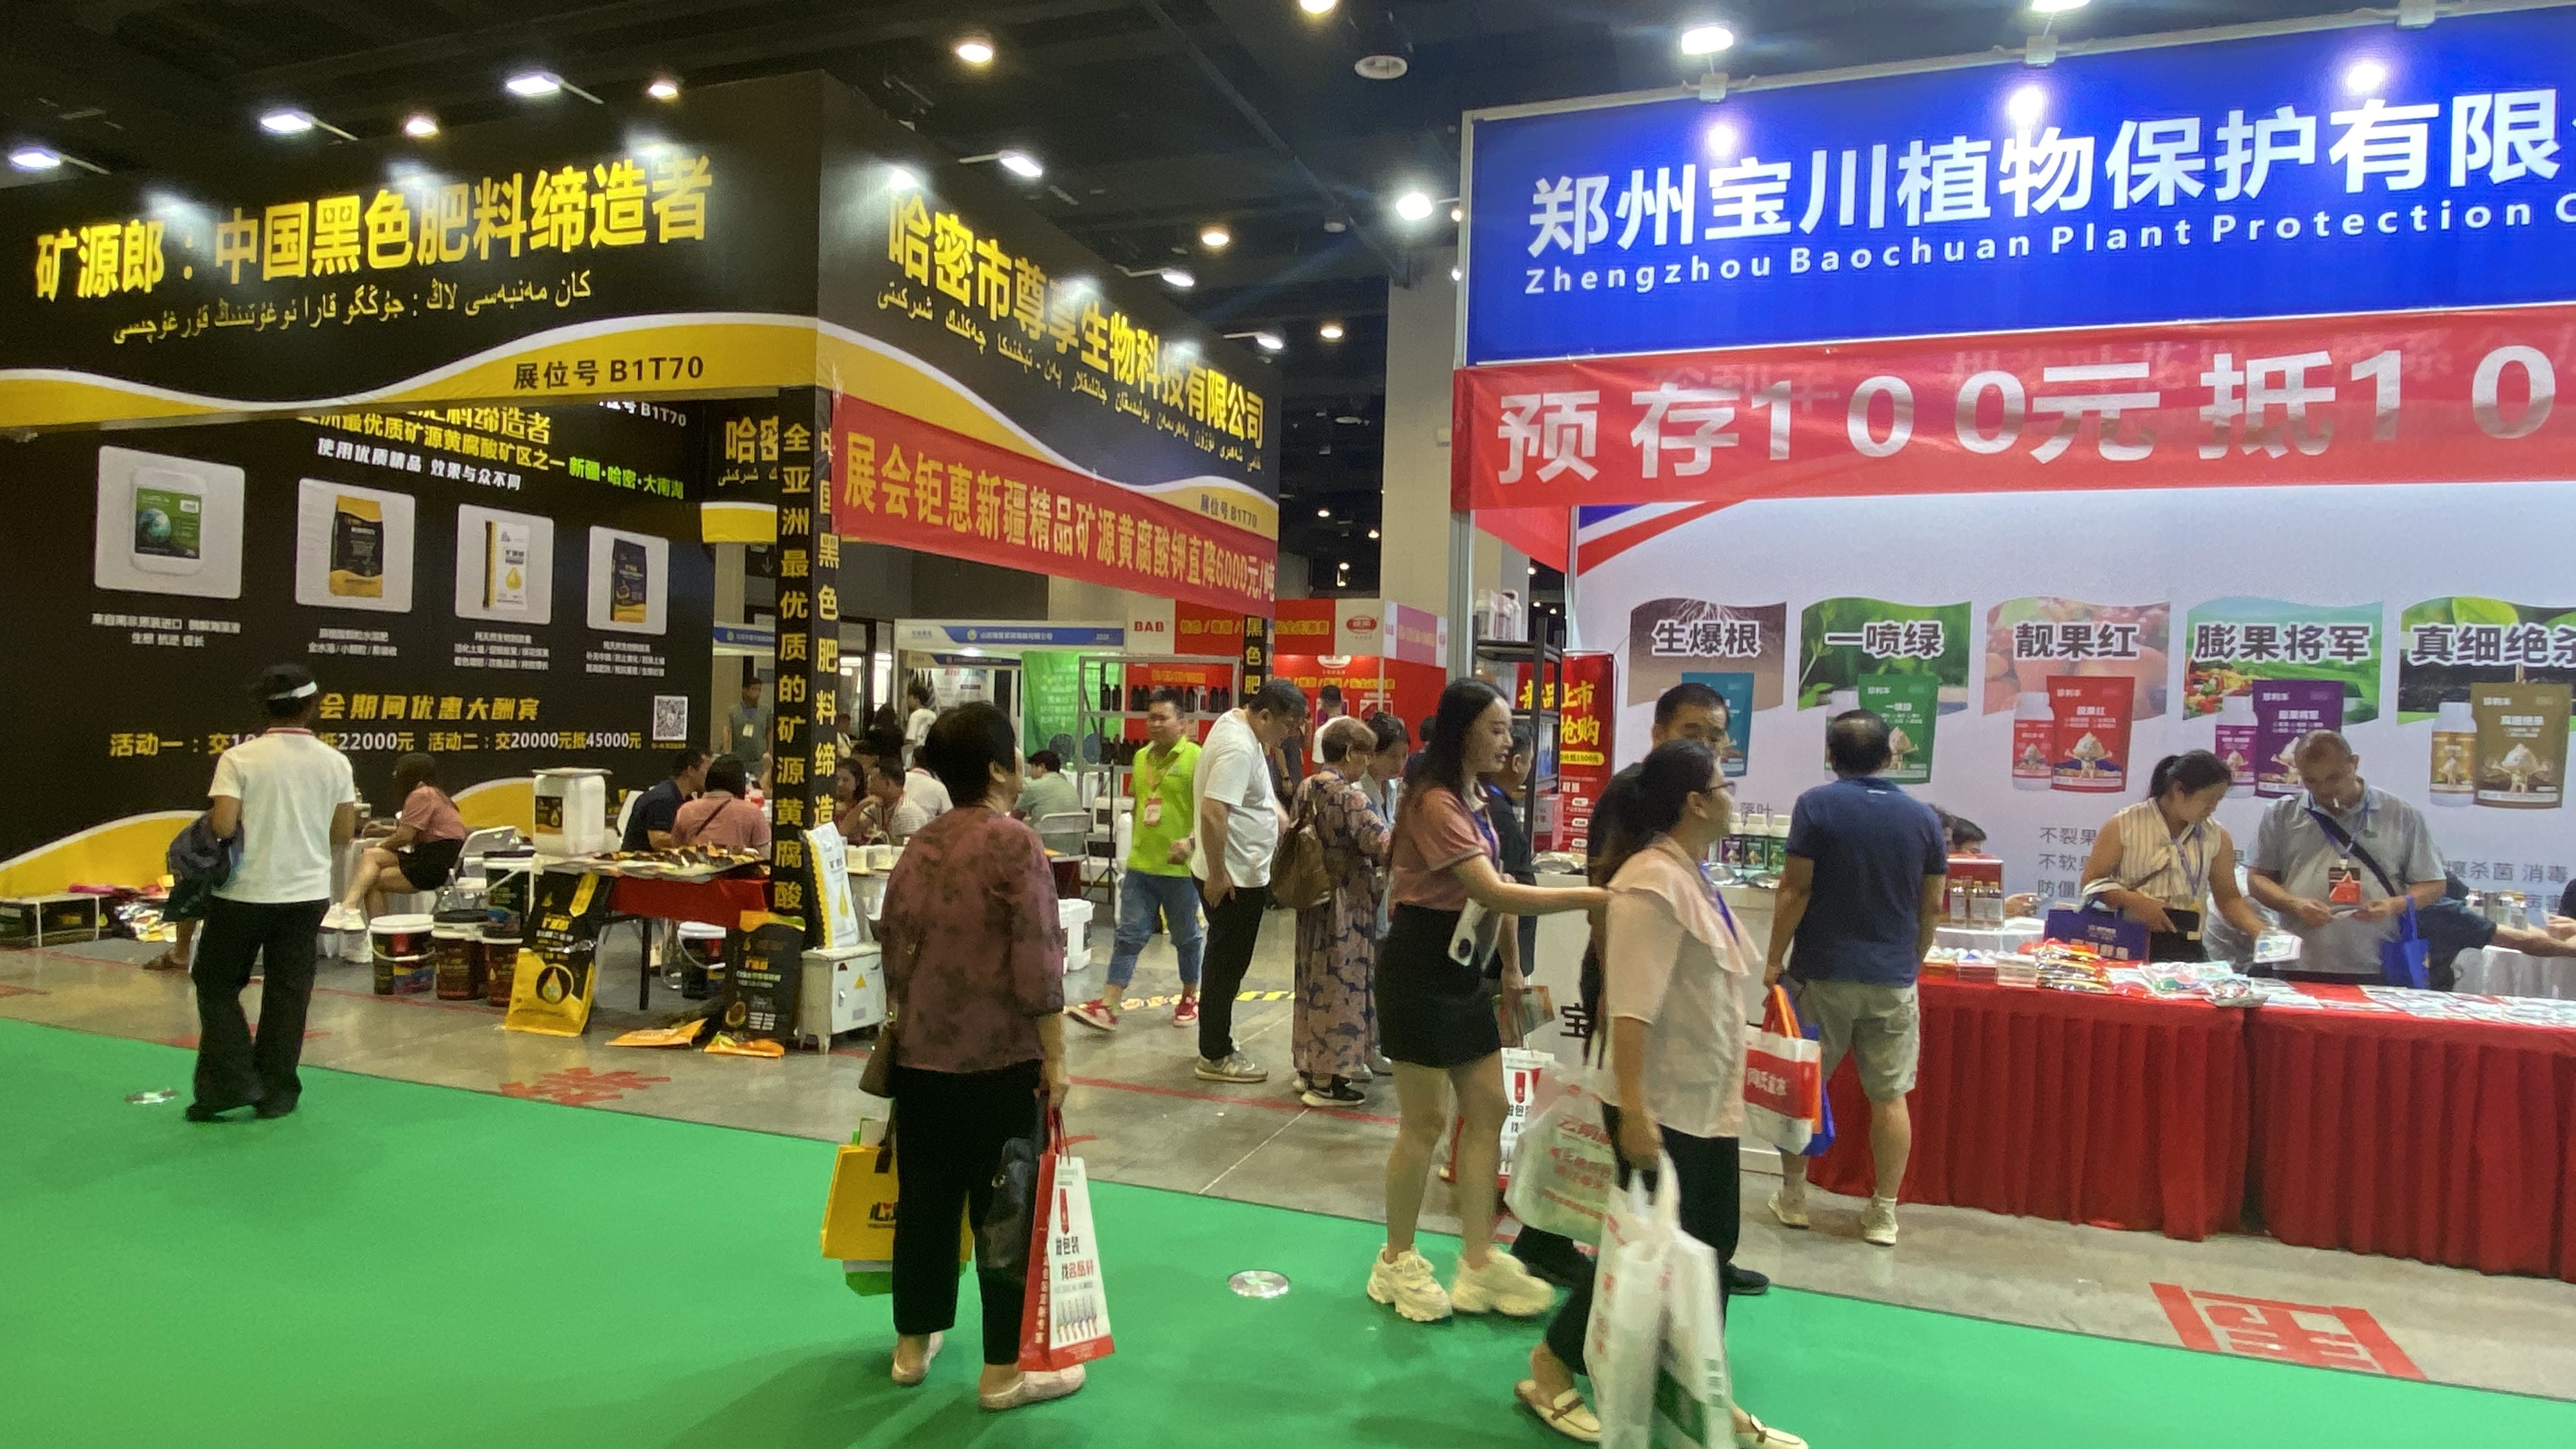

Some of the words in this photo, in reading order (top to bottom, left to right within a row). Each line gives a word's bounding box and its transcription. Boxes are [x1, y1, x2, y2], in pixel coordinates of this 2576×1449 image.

[35, 155, 712, 302] 矿源郎：中国黑色肥料缔造者
[1525, 256, 1770, 293] Zhengzhou
[1791, 236, 2029, 275] Baochuan
[2051, 219, 2191, 253] Plant
[2212, 200, 2531, 242] Protection
[889, 192, 1264, 450] 哈密市尊享生物科技有限公司
[513, 362, 599, 390] 展位号
[610, 356, 703, 382] B1T70
[431, 458, 522, 491] 效果与众不同
[1653, 622, 1761, 656] 生爆根
[1827, 622, 1943, 657] 一喷绿
[2015, 622, 2138, 659] 靓果红
[2195, 623, 2370, 662] 膨果将军
